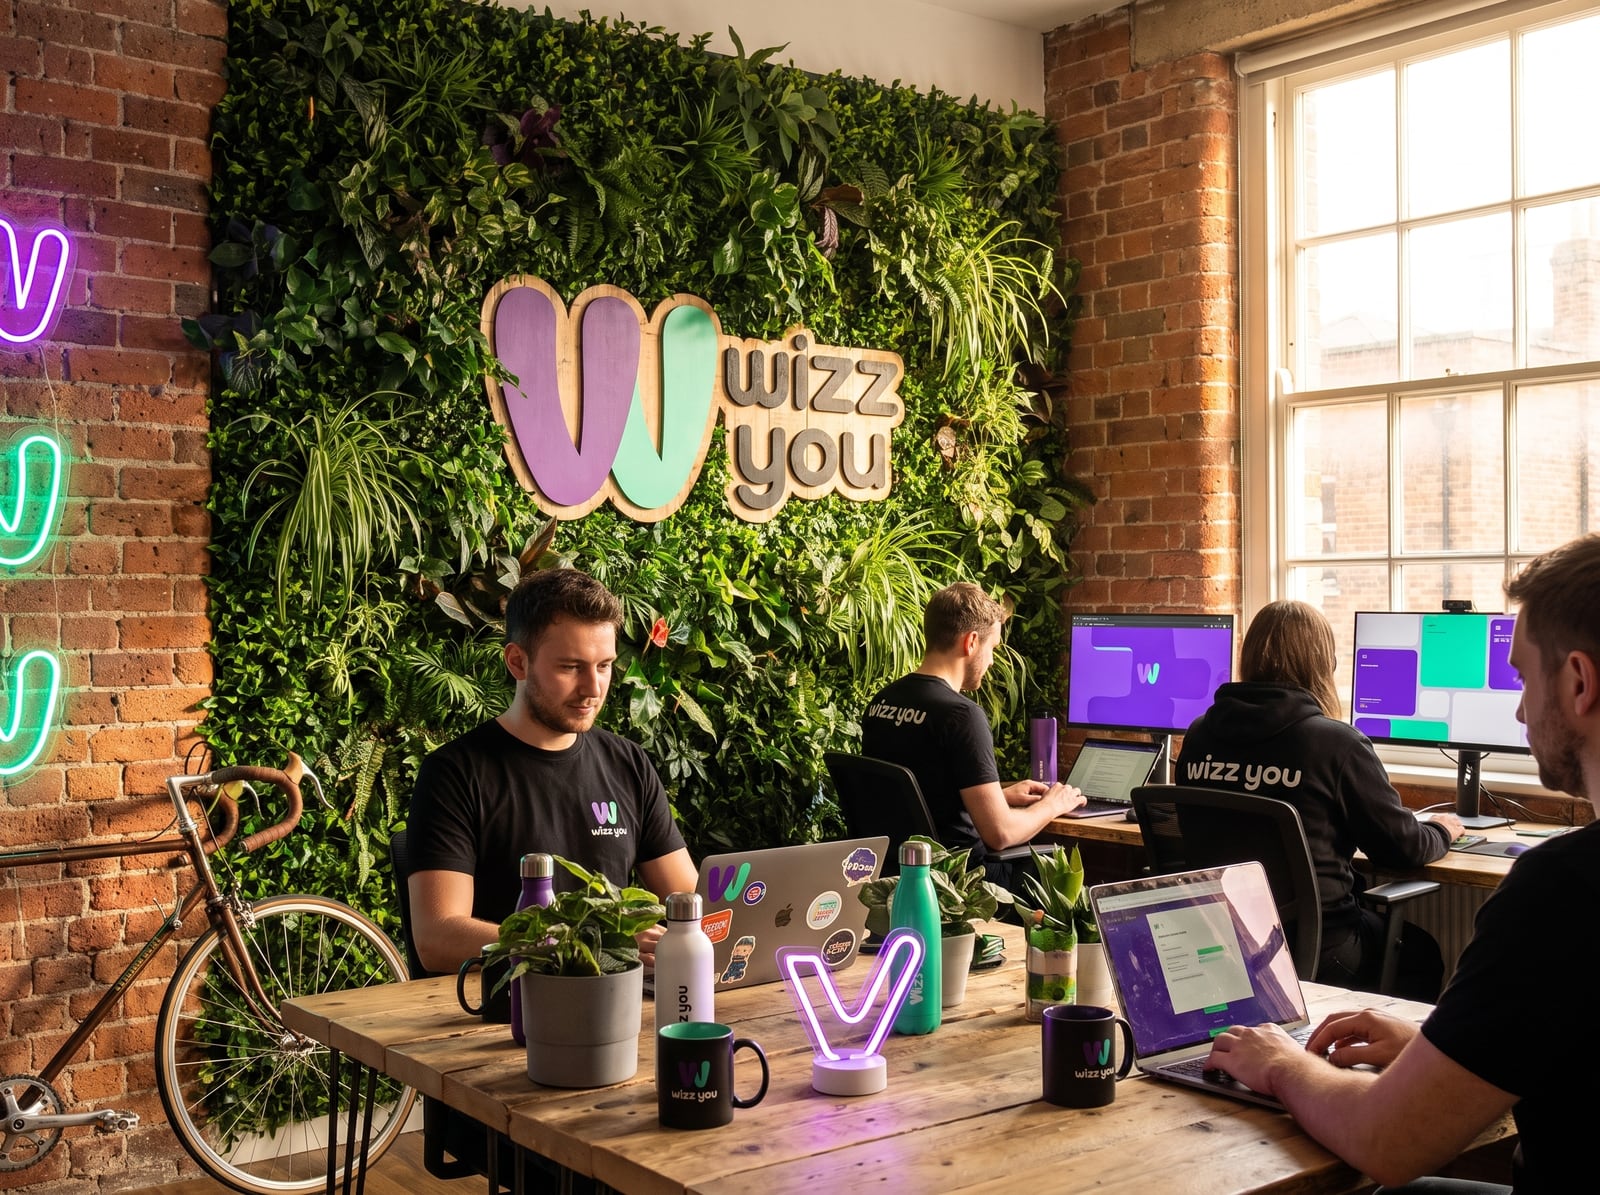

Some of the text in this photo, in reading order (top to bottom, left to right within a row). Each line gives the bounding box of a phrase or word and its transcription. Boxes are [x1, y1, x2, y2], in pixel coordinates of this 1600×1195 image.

[724, 334, 899, 417] wizz
[737, 424, 885, 510] you
[869, 699, 927, 727] wizz you
[1187, 754, 1302, 791] wizz you
[591, 826, 628, 838] wizz you
[679, 985, 692, 1013] you
[1074, 1066, 1115, 1080] wizz you
[671, 1089, 718, 1103] wizz you
